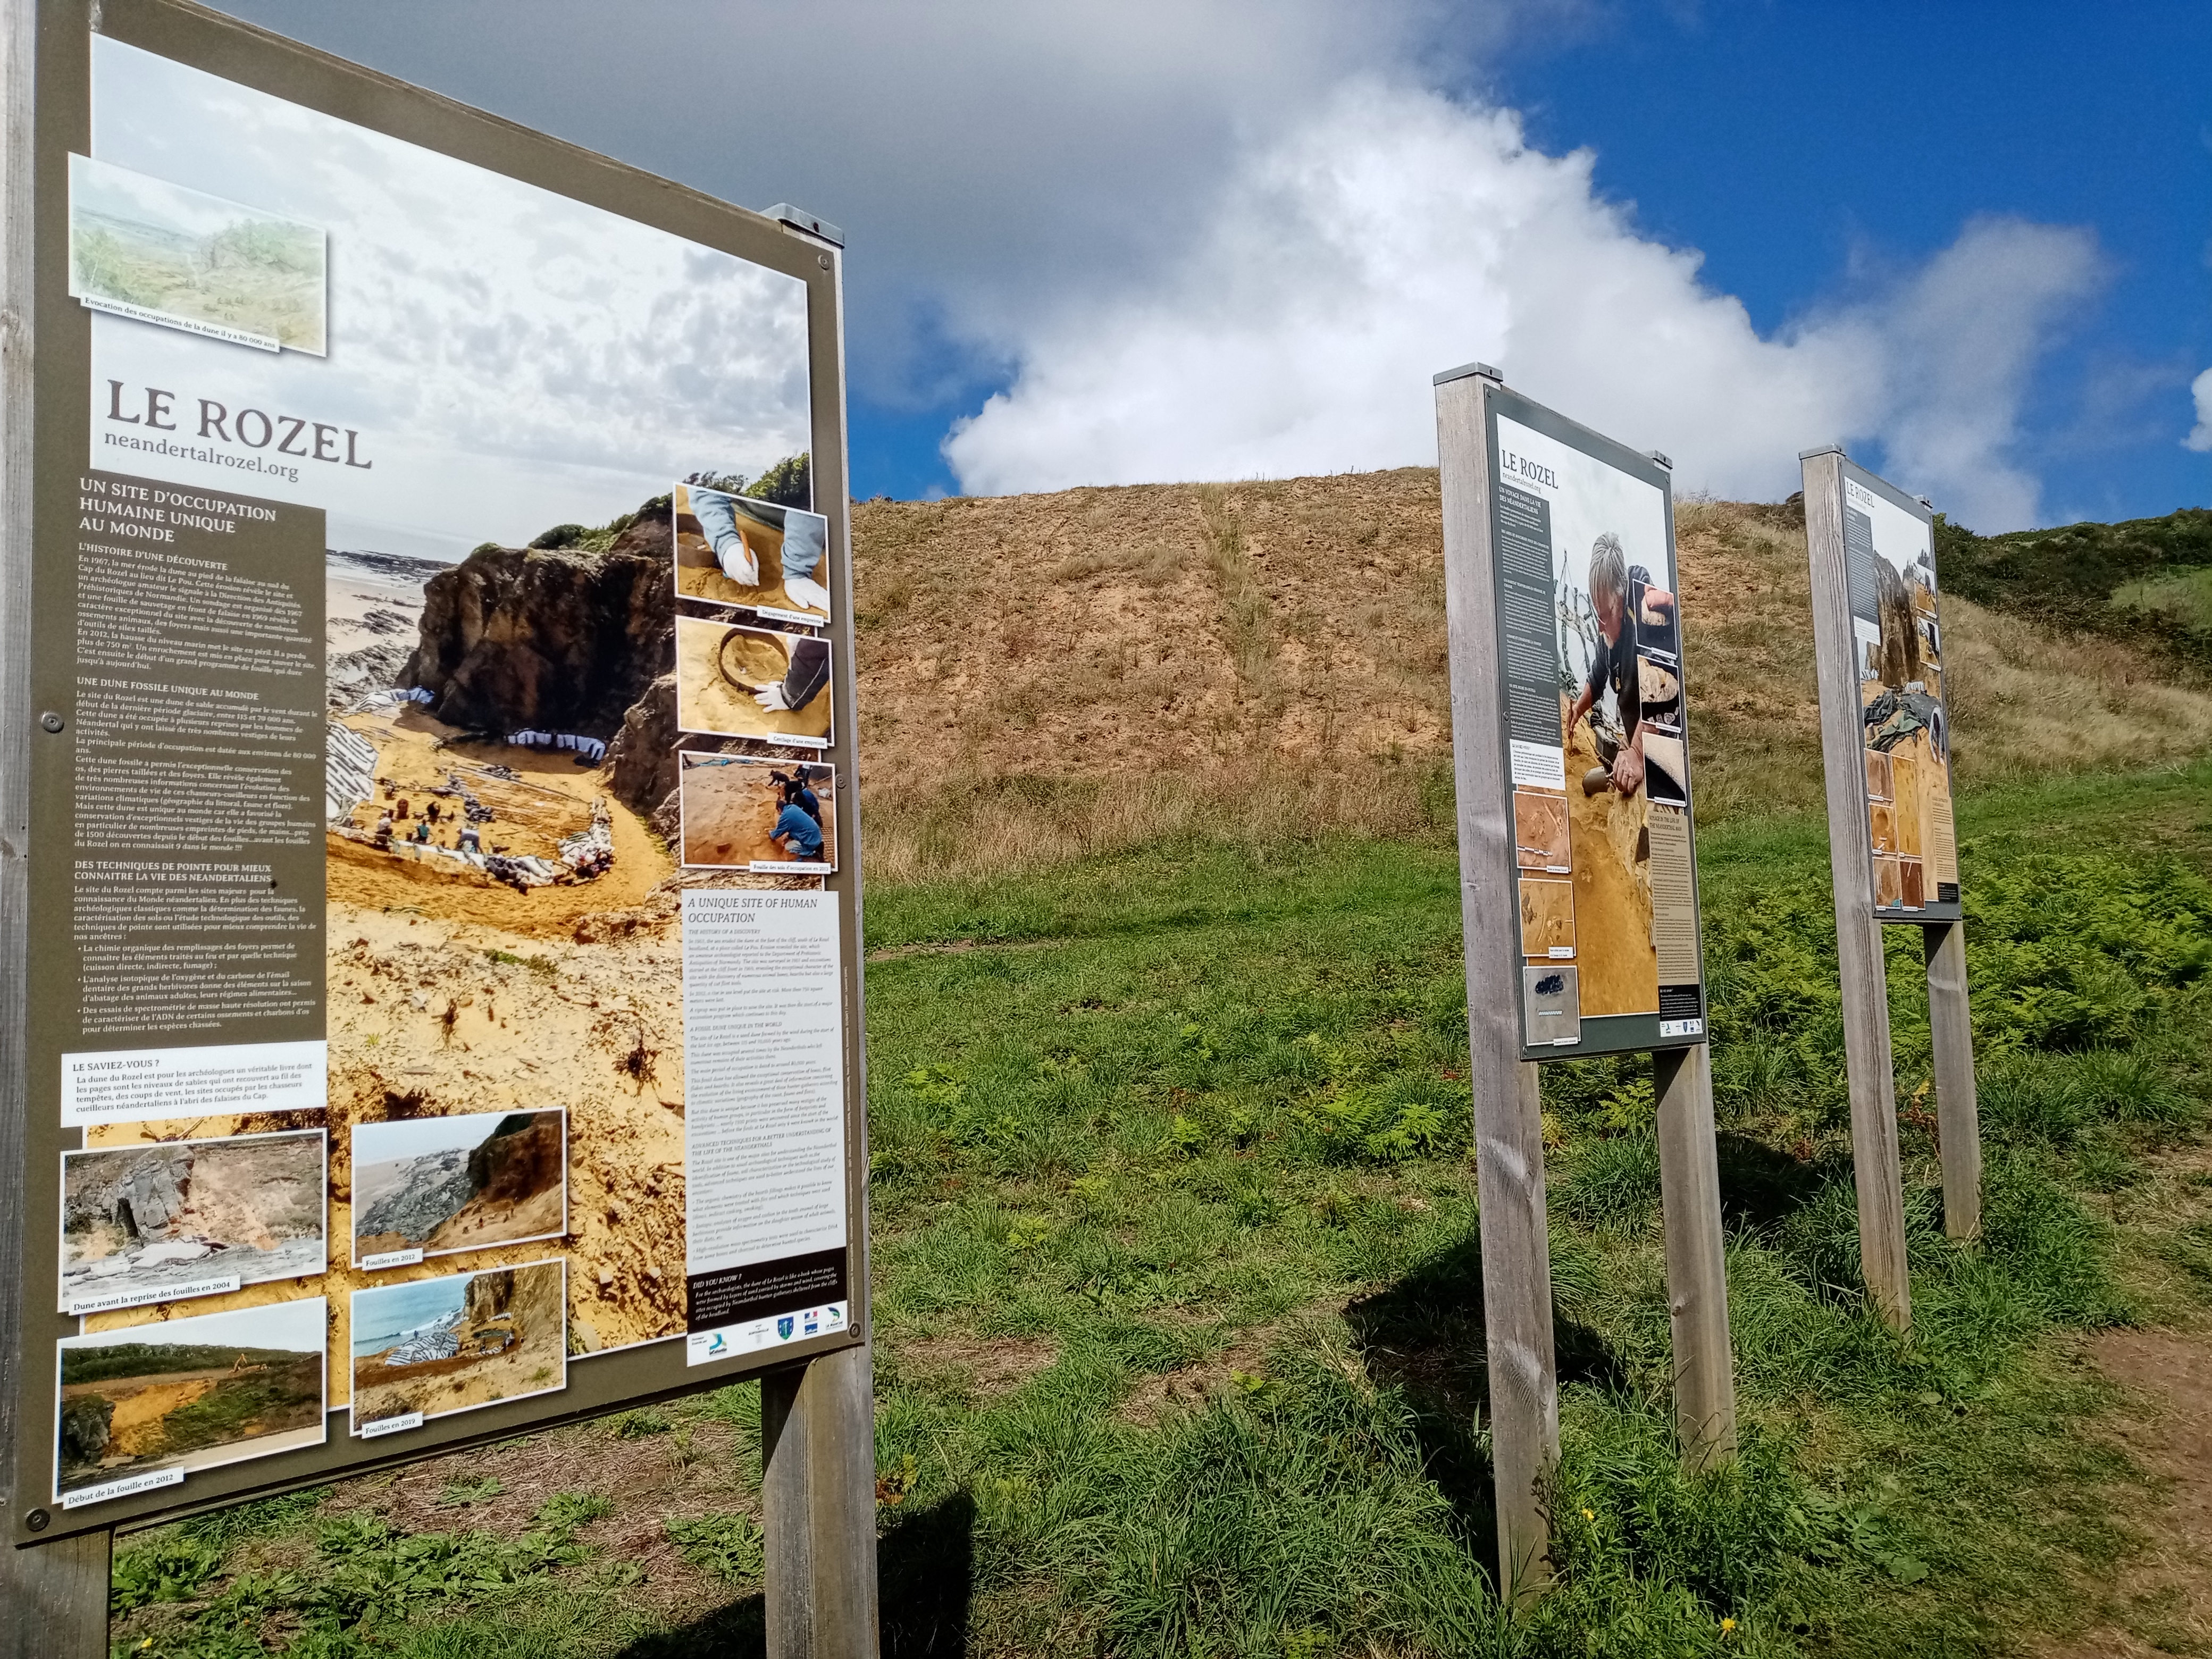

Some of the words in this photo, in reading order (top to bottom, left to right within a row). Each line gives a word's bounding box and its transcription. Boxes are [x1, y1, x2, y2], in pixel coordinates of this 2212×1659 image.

[85, 297, 122, 312] Evocation
[124, 306, 137, 315] des
[139, 312, 182, 326] occupations
[202, 324, 219, 334] dune
[249, 336, 262, 345] 000
[107, 379, 177, 430] LE
[197, 399, 372, 469] ROZEL
[105, 432, 299, 482] neandertalrozel.org
[1502, 449, 1516, 472] LE
[1520, 457, 1558, 489] ROZEL
[80, 478, 106, 493] UN
[111, 483, 149, 501] SITE
[154, 490, 276, 522] D'OCCUPATION
[1846, 482, 1854, 496] LE
[1855, 487, 1874, 507] ROZEL
[80, 497, 165, 522] HUMAINE
[170, 511, 235, 533] UNIQUE
[79, 516, 104, 532] AU
[110, 521, 174, 542] MONDE
[79, 542, 133, 557] L'HISTOIRE
[135, 550, 165, 562] D'UNE
[166, 554, 228, 570] DÉCOUVERTE
[77, 676, 97, 685] UNE
[100, 678, 128, 688] DUNE
[130, 681, 168, 692] FOSSILE
[171, 685, 207, 696] UNIQUE
[210, 688, 223, 697] AU
[225, 690, 258, 700] MONDE
[96, 861, 160, 870] TECHNIQUES
[189, 874, 271, 882] NEANDERTALIENS
[688, 898, 695, 907] A
[699, 898, 739, 909] UNIQUE
[741, 898, 763, 908] SITE
[766, 899, 778, 908] OF
[781, 899, 817, 908] HUMAN
[688, 912, 755, 922] OCCUPATION
[87, 1060, 152, 1070] SAVIEZ-VOUS
[209, 1077, 220, 1086] qui
[77, 1094, 114, 1103] tempêtes,
[215, 1085, 242, 1094] occupés
[116, 1100, 171, 1109] néandertaliens
[692, 1280, 704, 1289] DID
[705, 1278, 718, 1286] YOU
[718, 1274, 738, 1284] KNOW
[97, 1298, 118, 1307] avant
[130, 1293, 156, 1303] reprise
[173, 1286, 200, 1295] fouilles
[213, 1281, 230, 1289] 2004
[365, 1425, 390, 1434] Fouilles
[69, 1493, 93, 1504] Début
[117, 1482, 141, 1493] fouille
[156, 1474, 173, 1484] 2012
